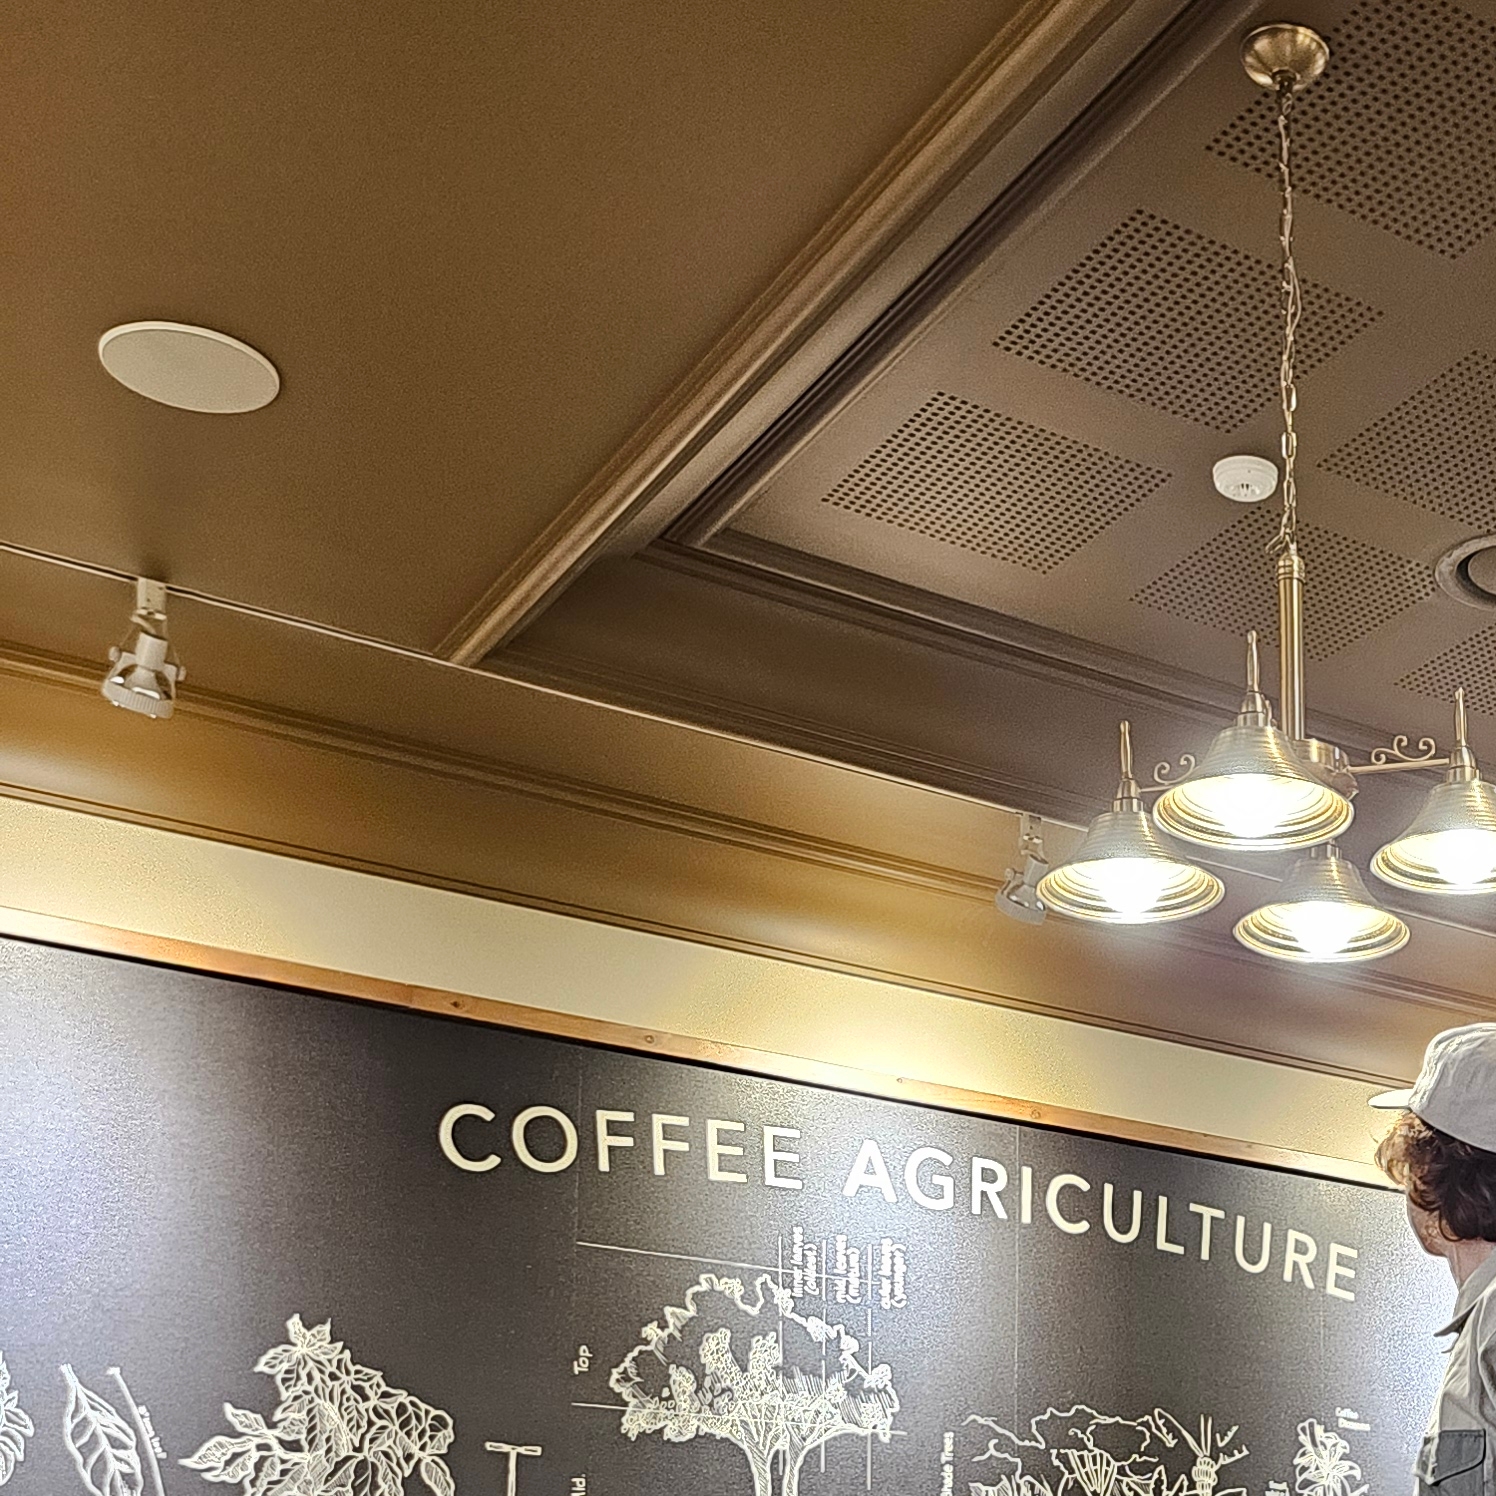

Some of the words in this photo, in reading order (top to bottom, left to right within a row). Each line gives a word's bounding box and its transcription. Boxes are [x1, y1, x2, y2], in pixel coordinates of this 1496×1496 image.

[438, 1102, 804, 1190] COFFEE
[841, 1138, 1360, 1302] AGRICULTURE
[573, 1345, 593, 1375] Top
[940, 1431, 955, 1464] Trees
